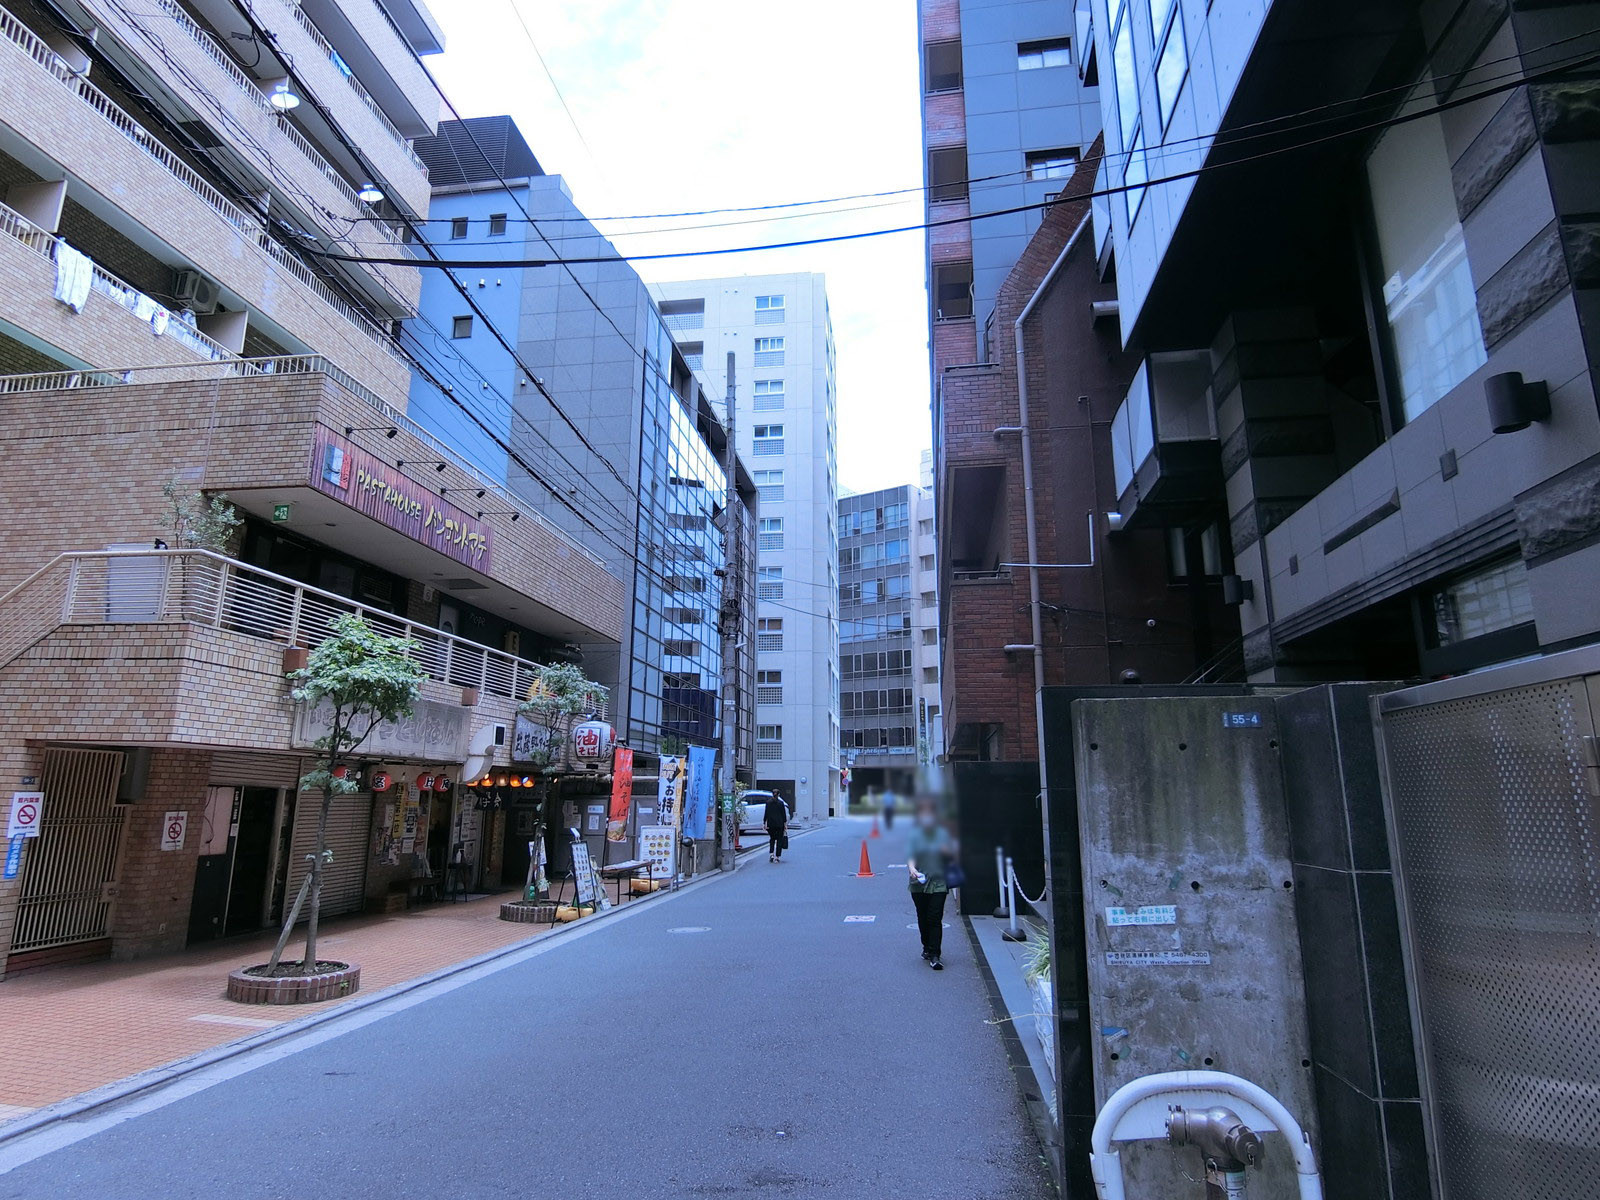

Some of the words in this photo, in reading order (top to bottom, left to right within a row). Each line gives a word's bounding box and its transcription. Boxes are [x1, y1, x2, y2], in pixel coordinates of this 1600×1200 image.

[356, 469, 421, 520] PASTAHOUSE
[1232, 714, 1258, 724] 55-4
[577, 728, 599, 746] 油
[578, 746, 598, 756] そば
[616, 777, 631, 817] 油そば
[1111, 907, 1175, 915] 事業みは有料シ
